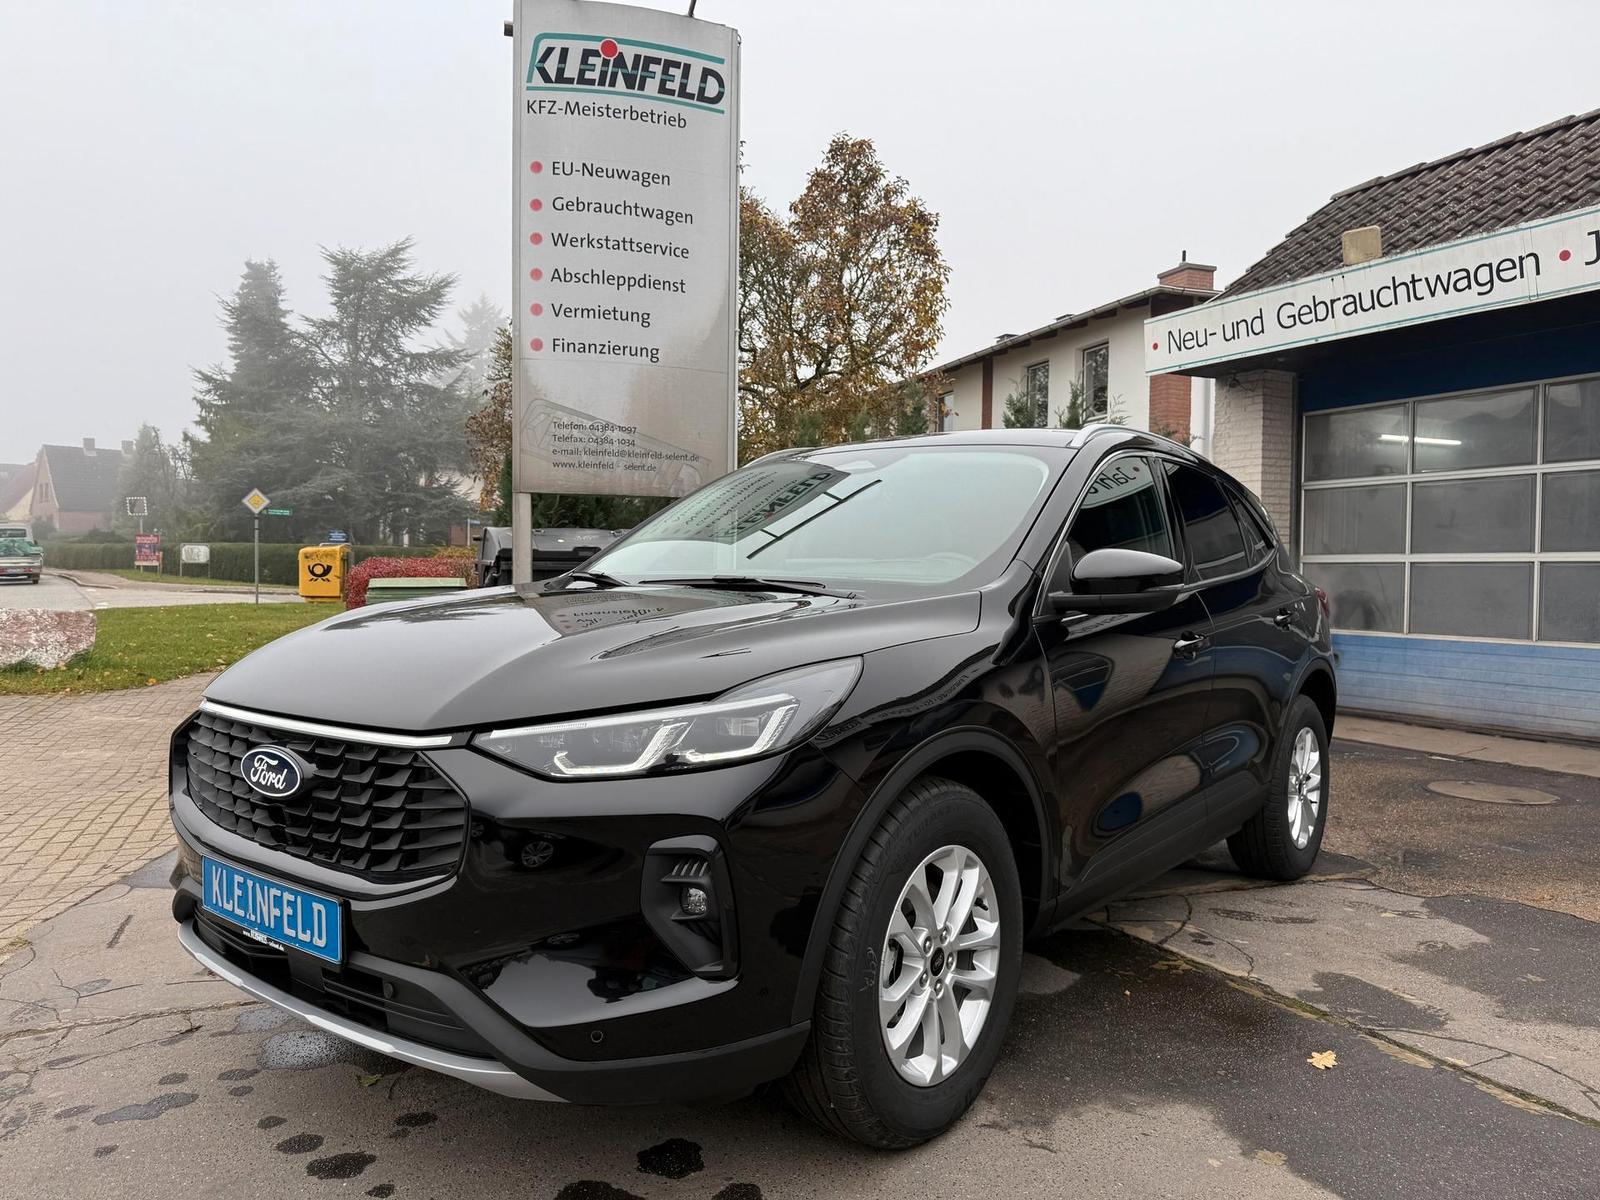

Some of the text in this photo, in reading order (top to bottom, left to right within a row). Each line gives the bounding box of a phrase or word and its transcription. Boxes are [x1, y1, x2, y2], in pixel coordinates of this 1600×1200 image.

[534, 40, 726, 105] KLEINFELD
[526, 100, 687, 129] KFZ-Meisterbetrieb
[552, 161, 671, 188] EU-Neuwagen
[552, 197, 694, 226] Gebrauchtwagen
[550, 232, 690, 259] Werkstattservice
[550, 267, 687, 294] Abschleppdienst
[1222, 306, 1265, 342] und
[1276, 250, 1541, 330] Gebrauchtwagen
[551, 303, 652, 328] Vermietung
[552, 338, 660, 364] Finanzierung
[552, 421, 637, 435] Telefon: 04384-1097
[552, 434, 636, 447] Telefax: 04384-1034
[552, 447, 700, 463] e-mail: kleinfeld@kleinfeld-selent.de
[552, 460, 614, 470] www.kleinfeld
[623, 463, 657, 472] selent.de
[250, 754, 288, 790] Ford
[211, 864, 328, 949] KLEINFELD
